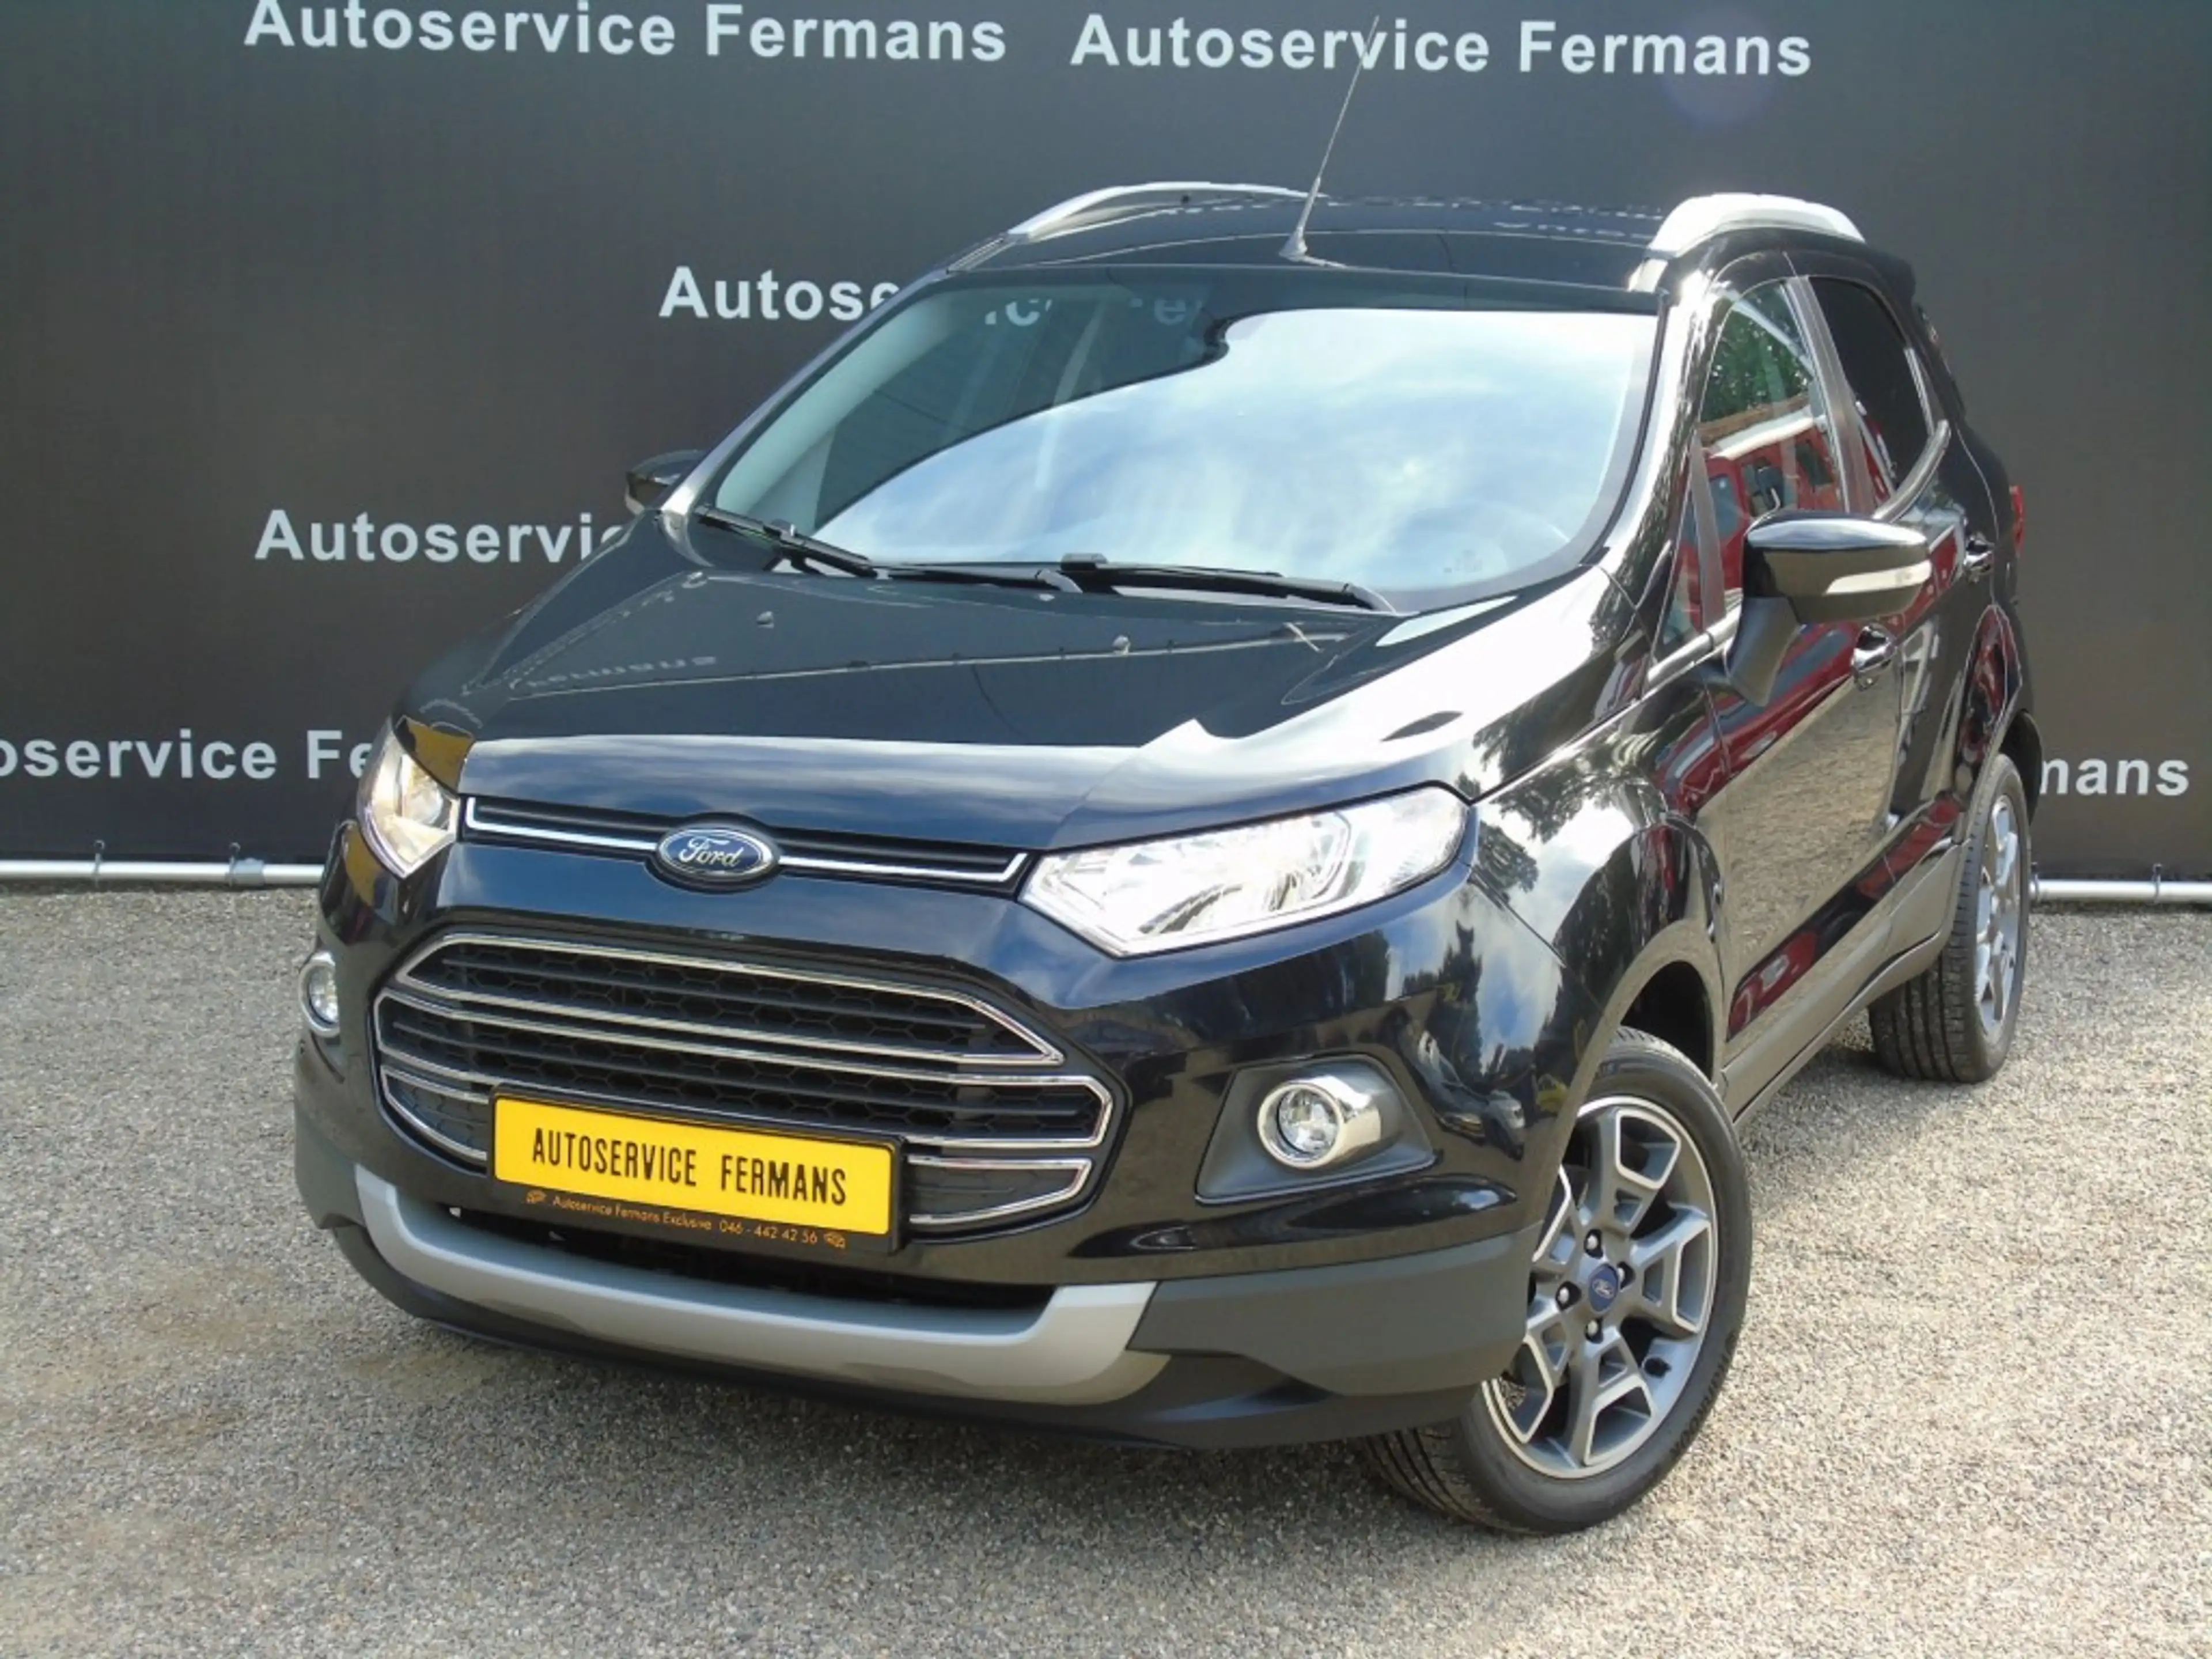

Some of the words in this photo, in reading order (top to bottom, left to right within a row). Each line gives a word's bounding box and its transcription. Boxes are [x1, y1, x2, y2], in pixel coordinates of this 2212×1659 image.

[243, 0, 676, 55] Autoservice
[706, 3, 1007, 62] Fermans
[1070, 14, 1490, 72] Autoservice
[1519, 21, 1812, 75] Fermans
[255, 509, 623, 563] Autoservi
[678, 835, 744, 866] Ford
[531, 1127, 697, 1187] AUTOSERVICE
[720, 1154, 846, 1206] FERMANS
